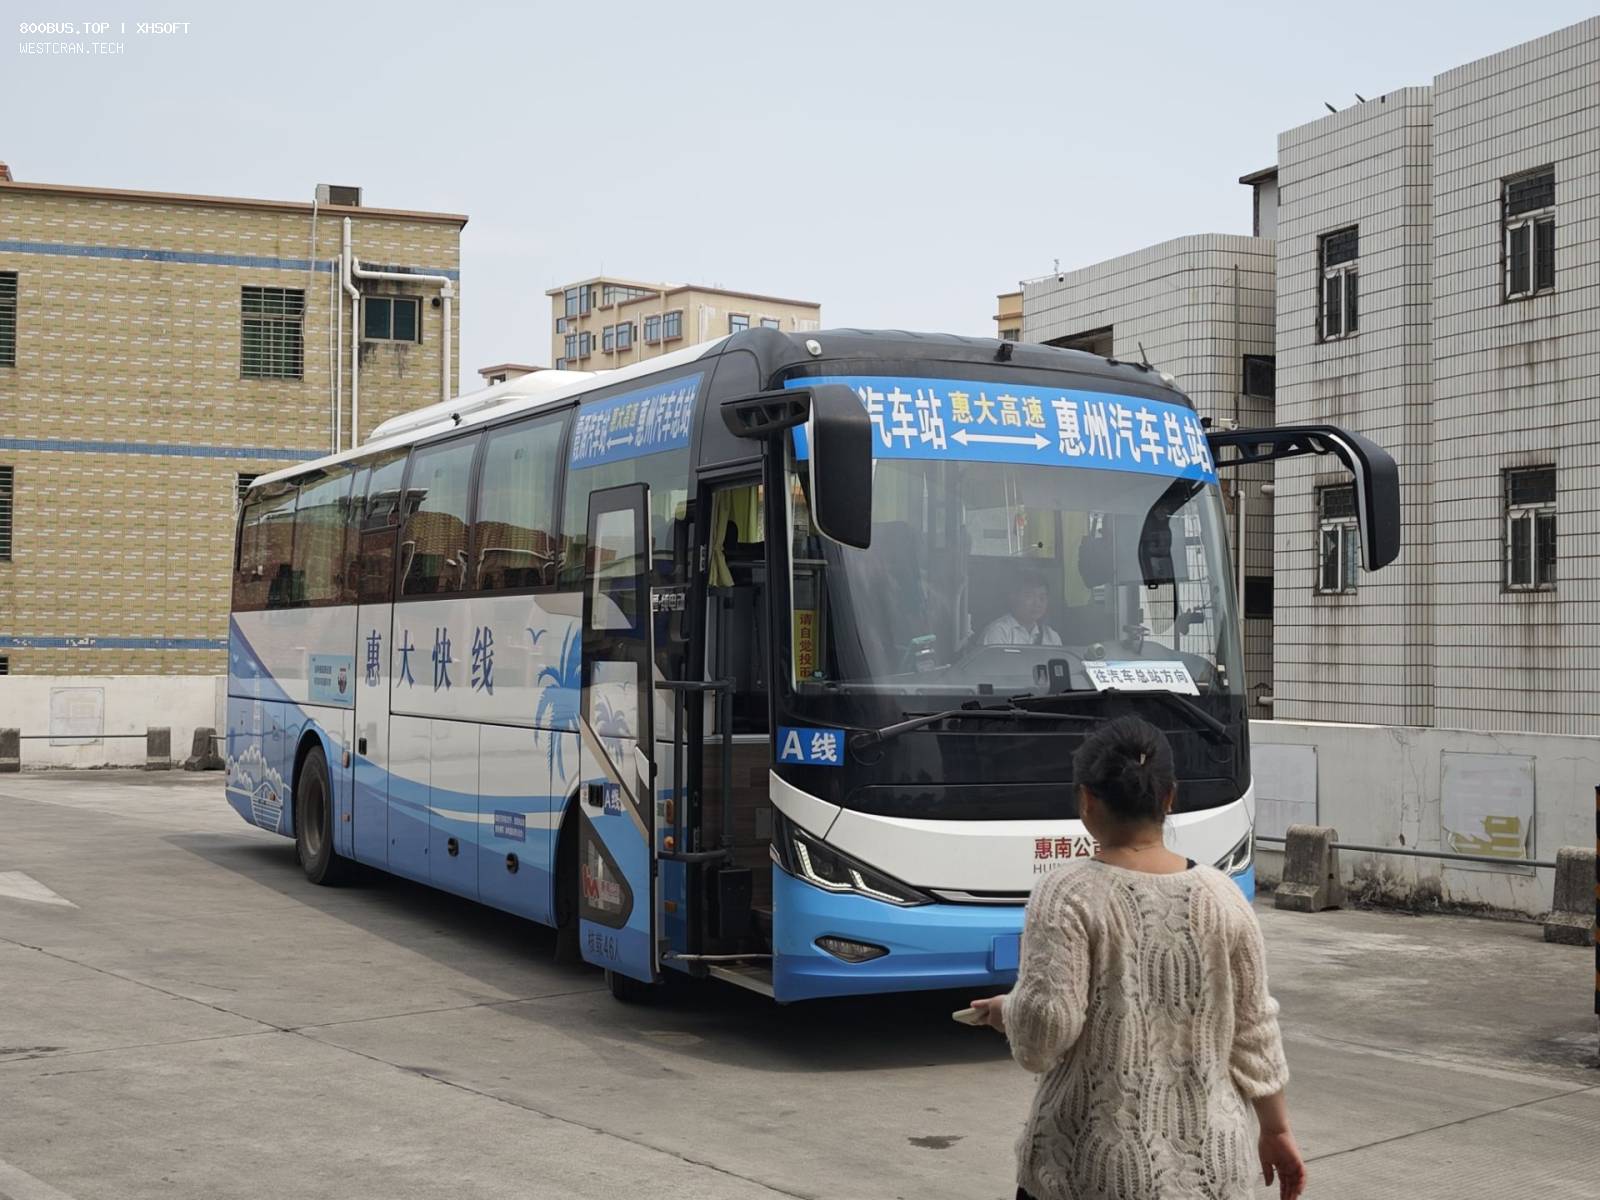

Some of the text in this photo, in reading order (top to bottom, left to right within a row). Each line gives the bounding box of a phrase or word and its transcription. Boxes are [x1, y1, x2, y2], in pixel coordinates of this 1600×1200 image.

[635, 384, 696, 447] 惠州汽车总站
[853, 385, 1212, 474] 汽车站 惠大高速 惠州汽车总站
[364, 626, 493, 696] 惠大快线
[799, 613, 812, 677] 请自觉投币
[1094, 668, 1189, 684] 往汽车总站方向
